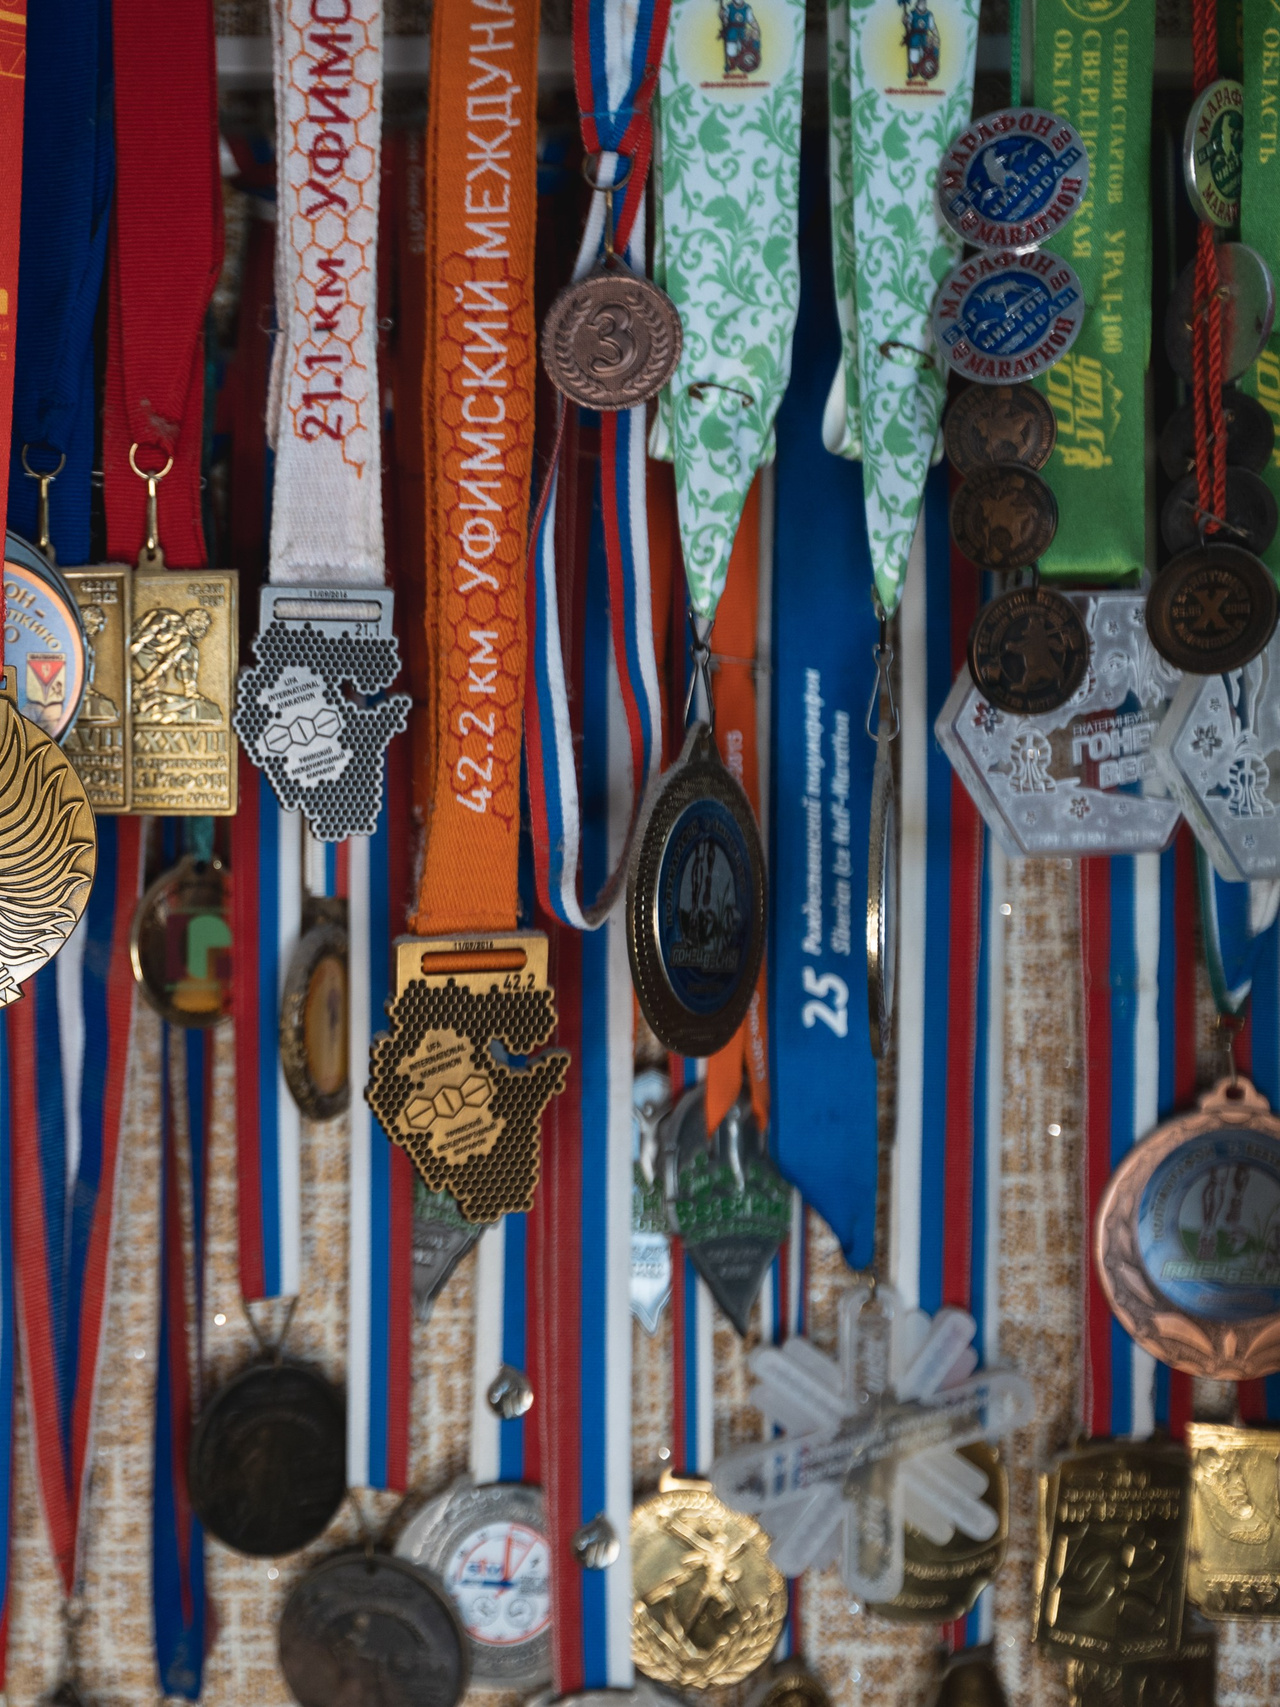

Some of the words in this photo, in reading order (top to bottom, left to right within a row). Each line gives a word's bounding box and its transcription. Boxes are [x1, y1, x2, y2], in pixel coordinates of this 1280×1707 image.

[1259, 28, 1280, 164] ОБЛАСТЬ
[942, 112, 1056, 190] МАРАФОН
[974, 176, 1082, 245] MARATHON
[586, 301, 638, 378] 3
[963, 316, 1076, 379] MARATHON
[300, 354, 344, 441] 21.1
[455, 280, 510, 592] УФИМСКИЙ
[355, 623, 381, 637] 21,1
[268, 680, 321, 702] INTERNATIONAL
[284, 676, 299, 687] UFA
[277, 692, 317, 710] MARATHON
[291, 751, 347, 776] МЕЖДУНАРОДНЫЙ
[298, 746, 334, 765] УФИМСКИЙ
[456, 711, 496, 812] 42.2
[306, 764, 337, 781] МАРАФОН
[503, 974, 535, 992] 42,2
[802, 966, 850, 1038] 25
[408, 1043, 468, 1072] INTERNATIONAL
[426, 1040, 442, 1053] UFA
[419, 1057, 464, 1079] MARATHON
